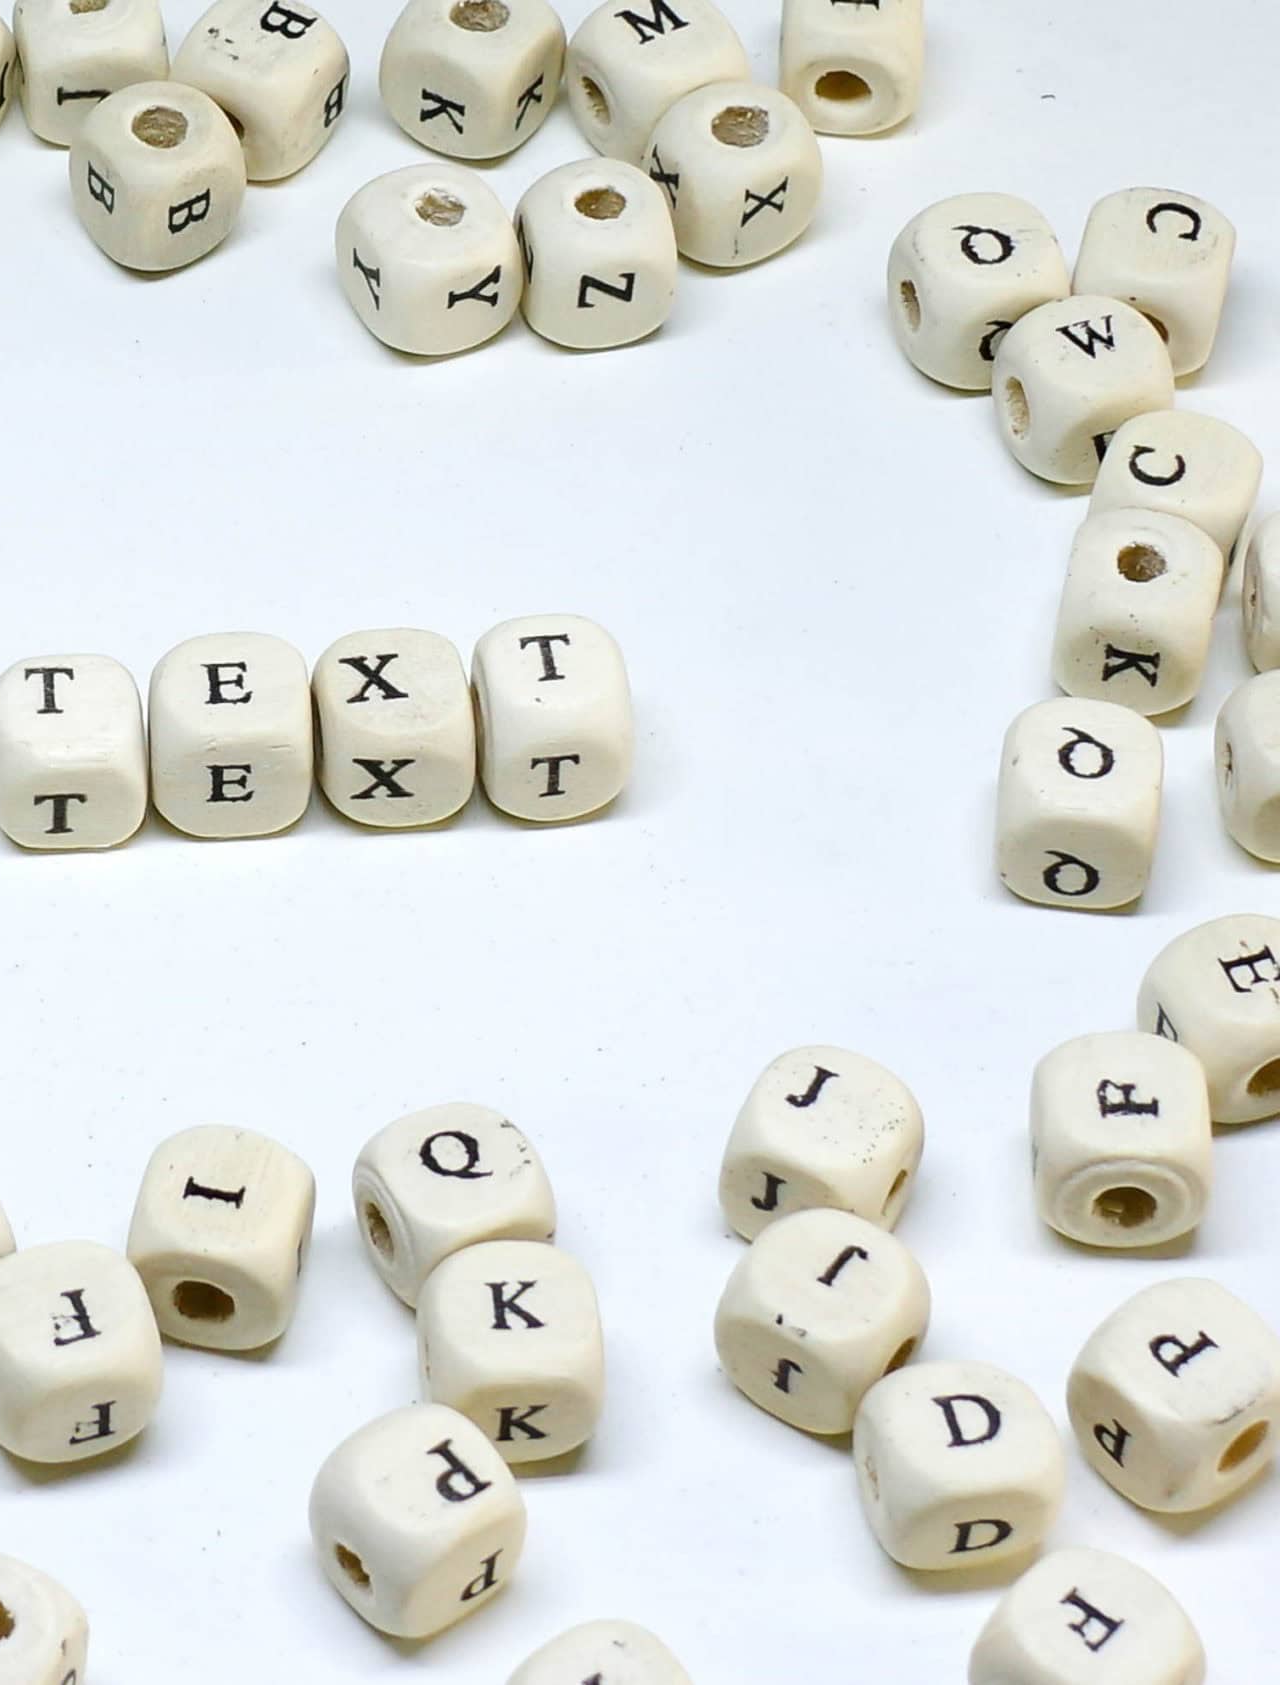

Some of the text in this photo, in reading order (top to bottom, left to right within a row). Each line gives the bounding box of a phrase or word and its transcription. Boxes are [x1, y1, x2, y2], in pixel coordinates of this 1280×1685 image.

[259, 0, 318, 40] B
[613, 0, 690, 46] M
[323, 72, 348, 129] B
[418, 87, 467, 136] K
[514, 71, 546, 132] K
[86, 161, 116, 216] B
[648, 144, 681, 210] X
[166, 187, 212, 236] B
[739, 176, 789, 229] X
[1145, 201, 1203, 243] C
[951, 224, 1016, 266] Q
[446, 264, 502, 310] Y
[1054, 313, 1116, 359] W
[1128, 444, 1187, 488] C
[24, 633, 571, 715] TEXT
[1100, 642, 1162, 689] K
[1057, 726, 1116, 780] Q
[32, 753, 581, 835] TEXT
[1041, 849, 1102, 898] Q
[1215, 943, 1280, 994] E
[785, 1065, 839, 1109] J
[1096, 1077, 1160, 1118] F
[418, 1130, 493, 1180] Q
[182, 1176, 247, 1210] I
[749, 1170, 788, 1213] J
[487, 1280, 546, 1331] K
[1148, 1330, 1219, 1378] P
[494, 1403, 548, 1443] K
[933, 1394, 1002, 1448] D
[1092, 1418, 1133, 1469] P
[427, 1438, 492, 1502] P
[949, 1518, 1014, 1555] D
[459, 1546, 505, 1603] P
[1059, 1585, 1124, 1654] F
